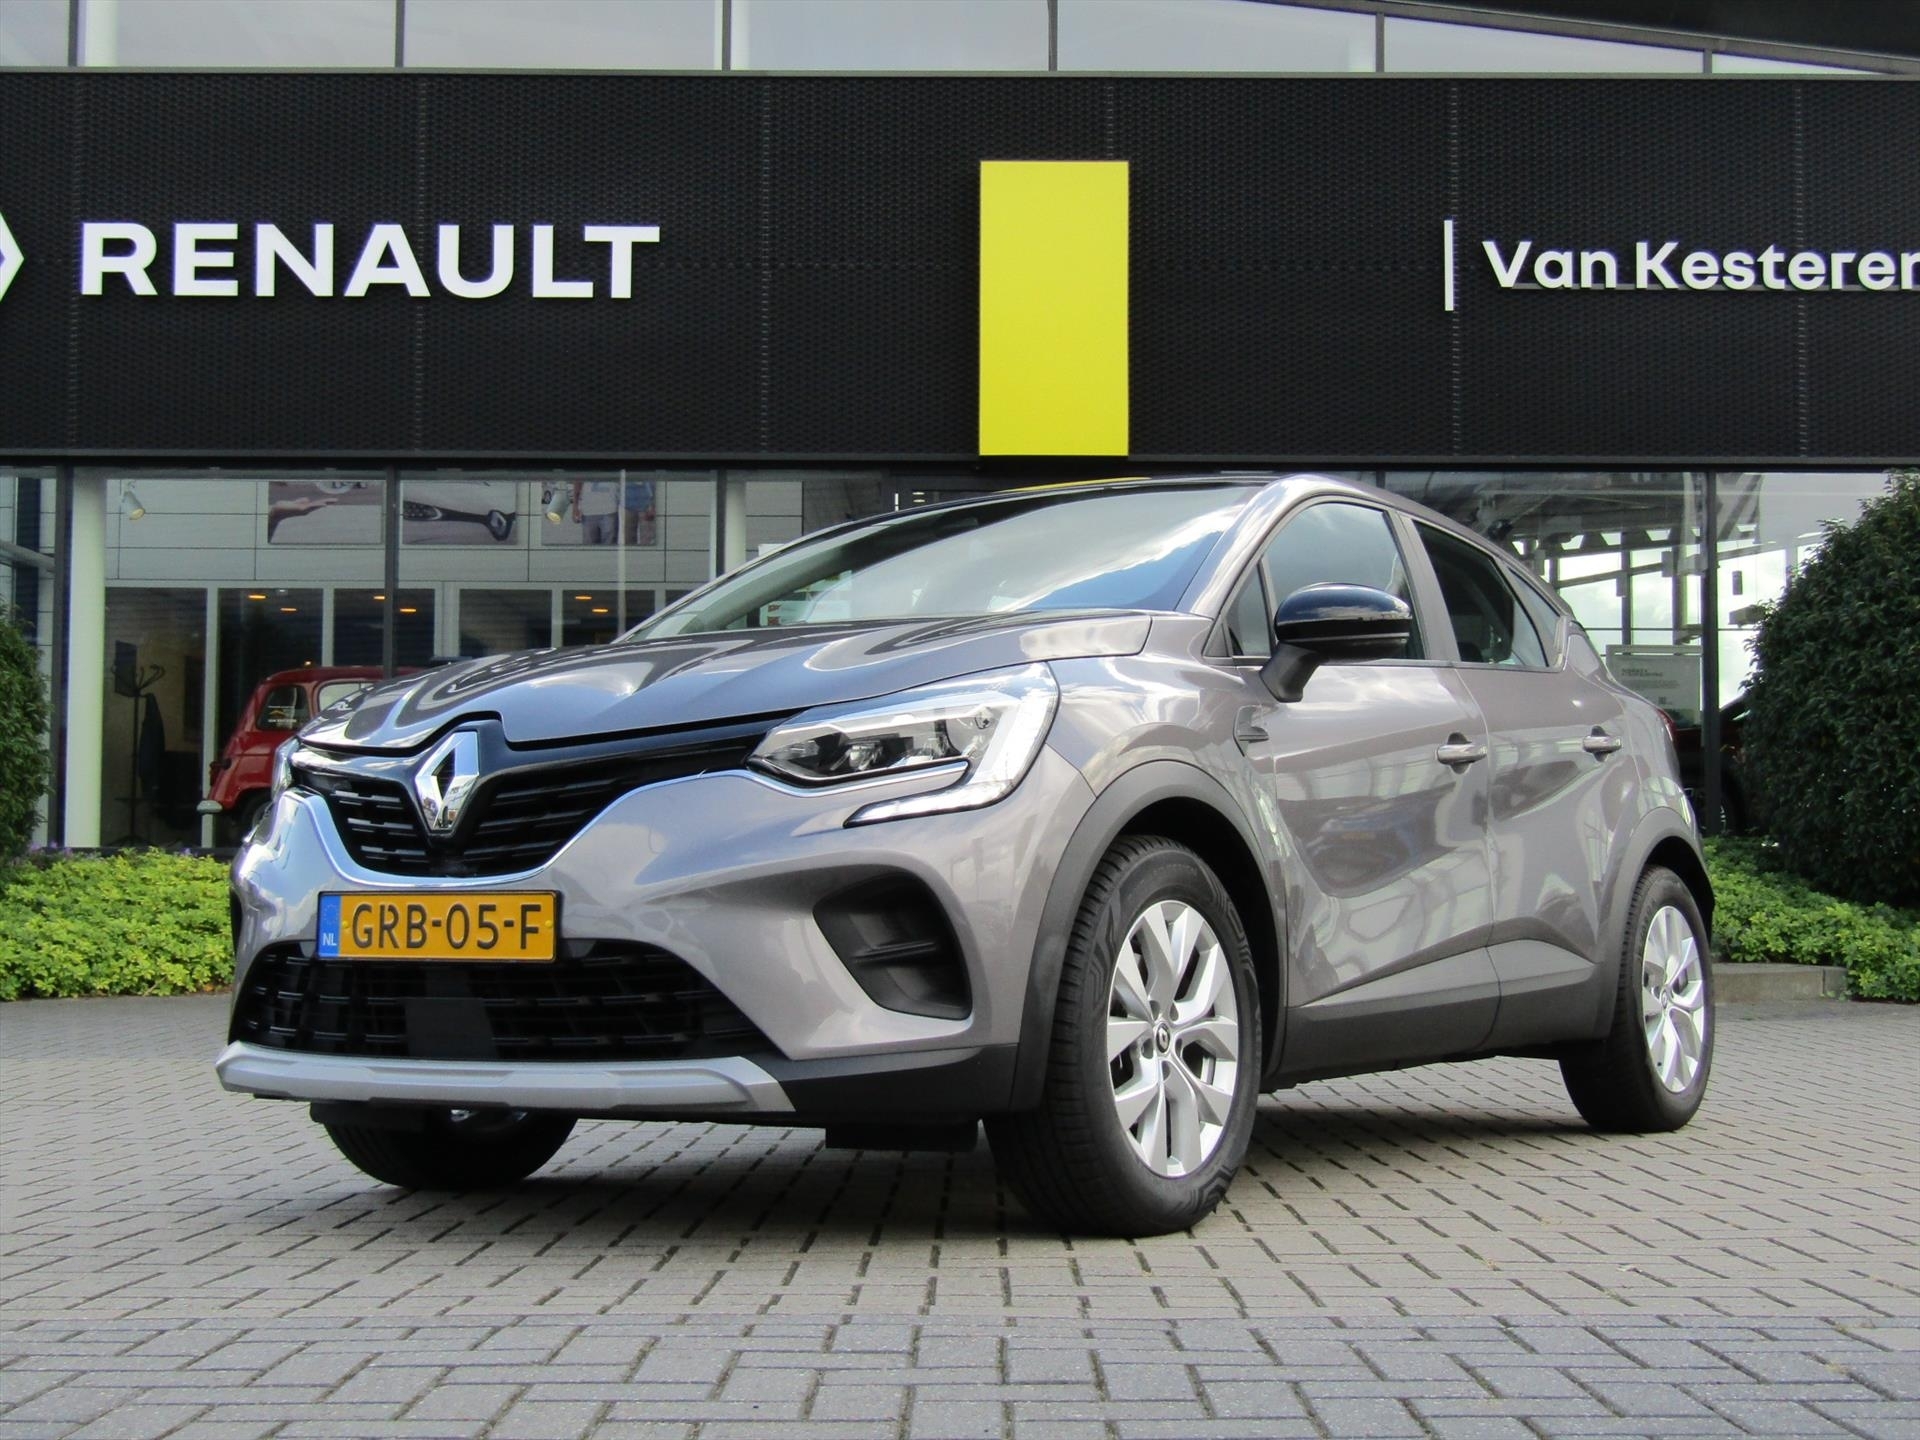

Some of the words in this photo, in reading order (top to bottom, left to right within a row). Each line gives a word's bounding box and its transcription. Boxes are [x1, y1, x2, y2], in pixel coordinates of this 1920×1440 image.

[80, 222, 661, 299] RENAULT
[1482, 240, 1618, 289] Van
[322, 932, 338, 947] NL
[352, 903, 542, 950] GRB-05-F
